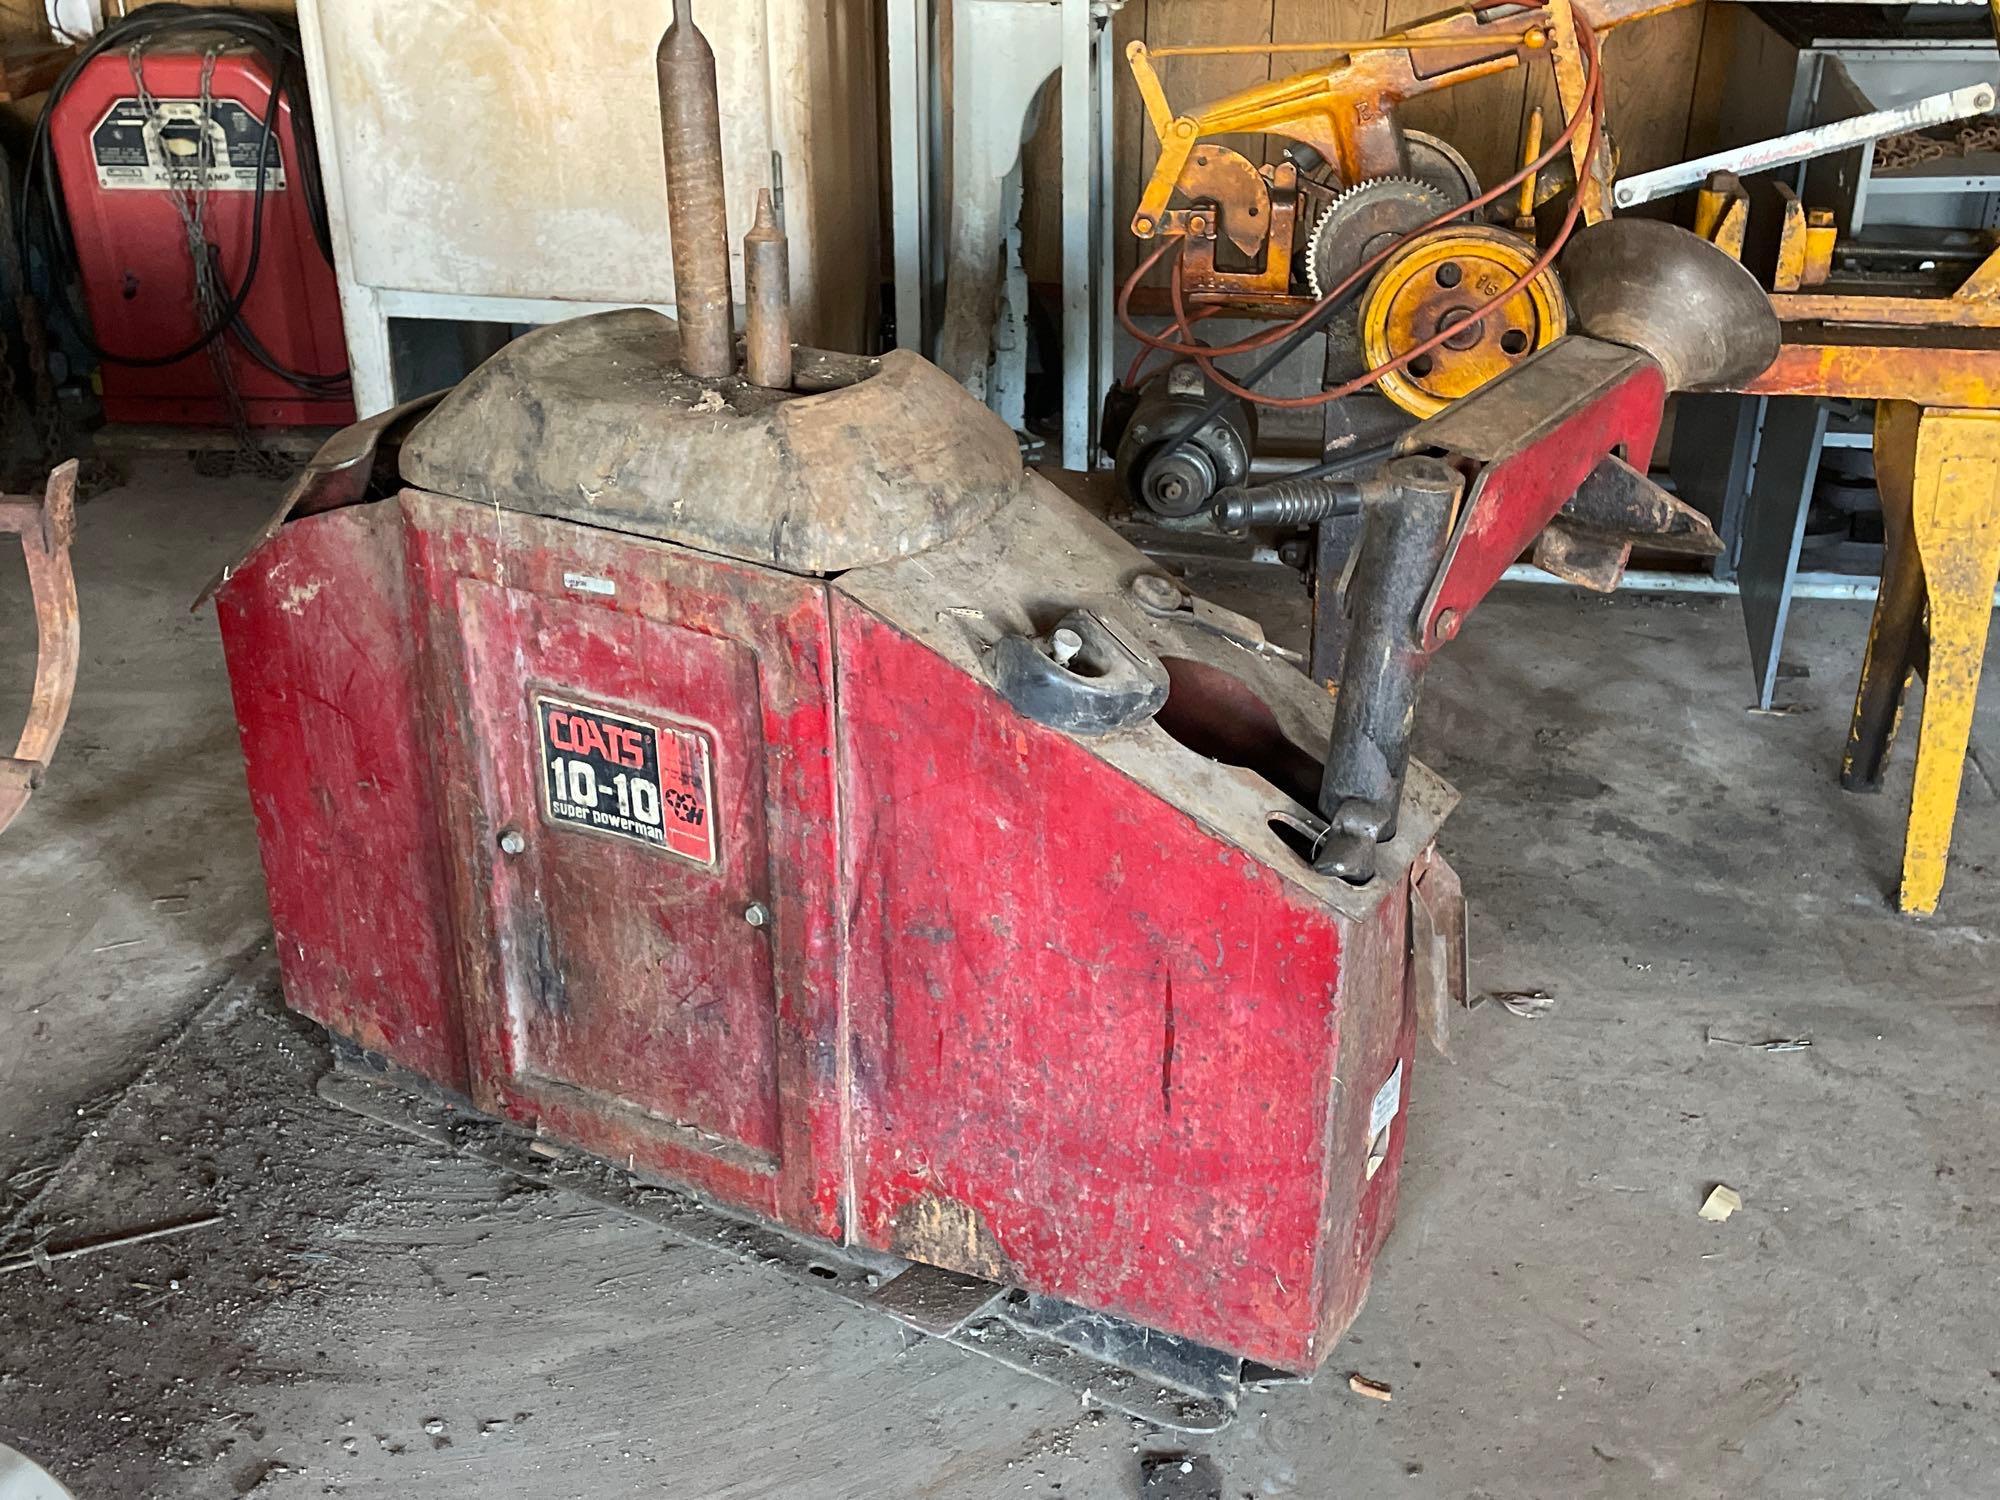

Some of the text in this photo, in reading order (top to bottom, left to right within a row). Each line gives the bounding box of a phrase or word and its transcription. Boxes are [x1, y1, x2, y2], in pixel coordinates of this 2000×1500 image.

[207, 173, 231, 182] AMP
[549, 711, 644, 770] COATS
[551, 756, 661, 826] 10-10
[552, 801, 590, 820] super
[592, 809, 664, 841] powerman
